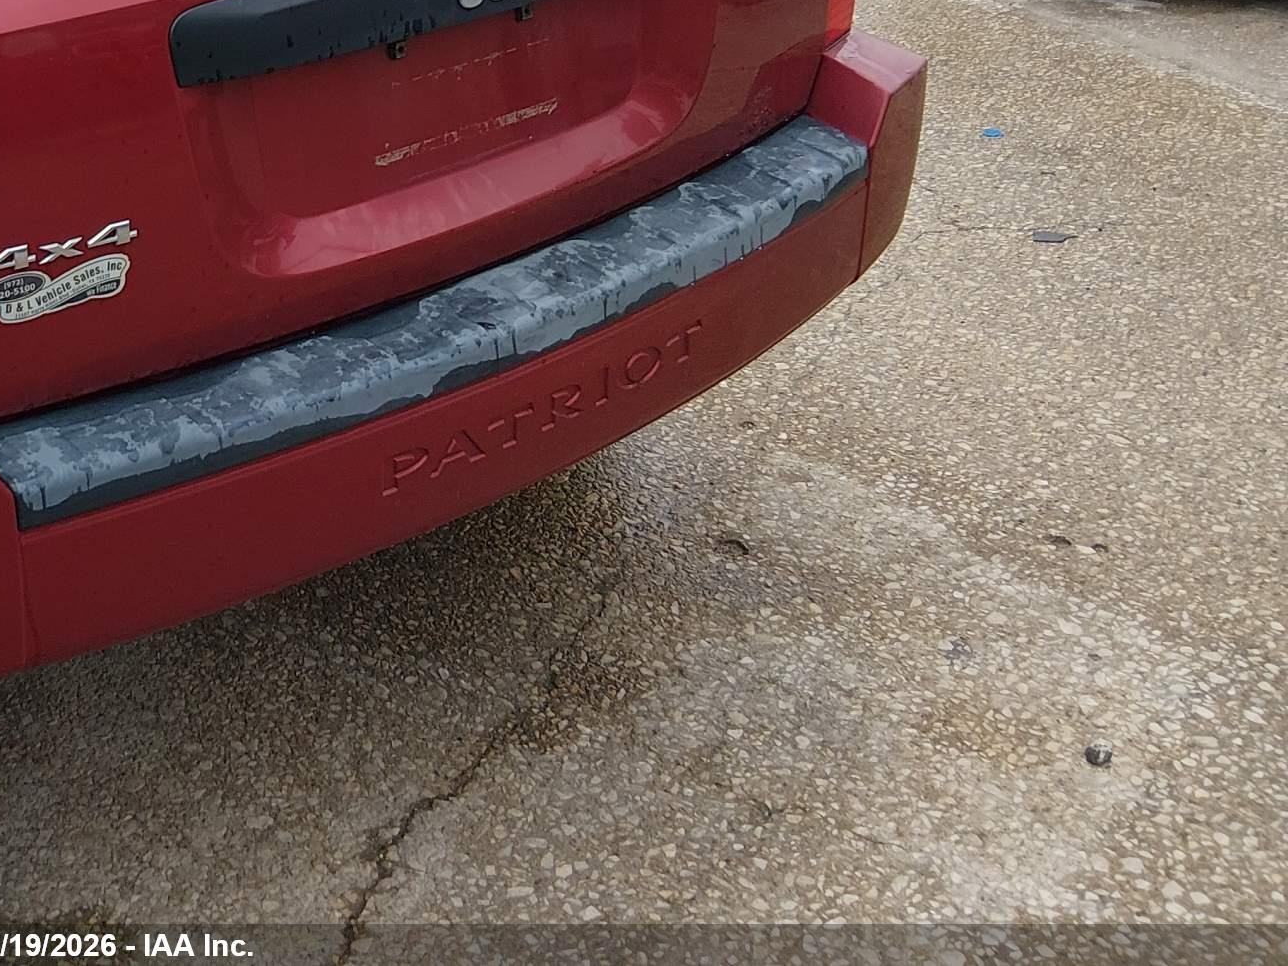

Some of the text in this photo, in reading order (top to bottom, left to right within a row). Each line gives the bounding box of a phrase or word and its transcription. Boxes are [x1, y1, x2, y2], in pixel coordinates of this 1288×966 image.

[5, 303, 12, 314] D
[16, 302, 24, 312] &
[27, 300, 33, 310] L
[34, 281, 72, 307] Vehicle
[381, 319, 704, 497] PATRIOT
